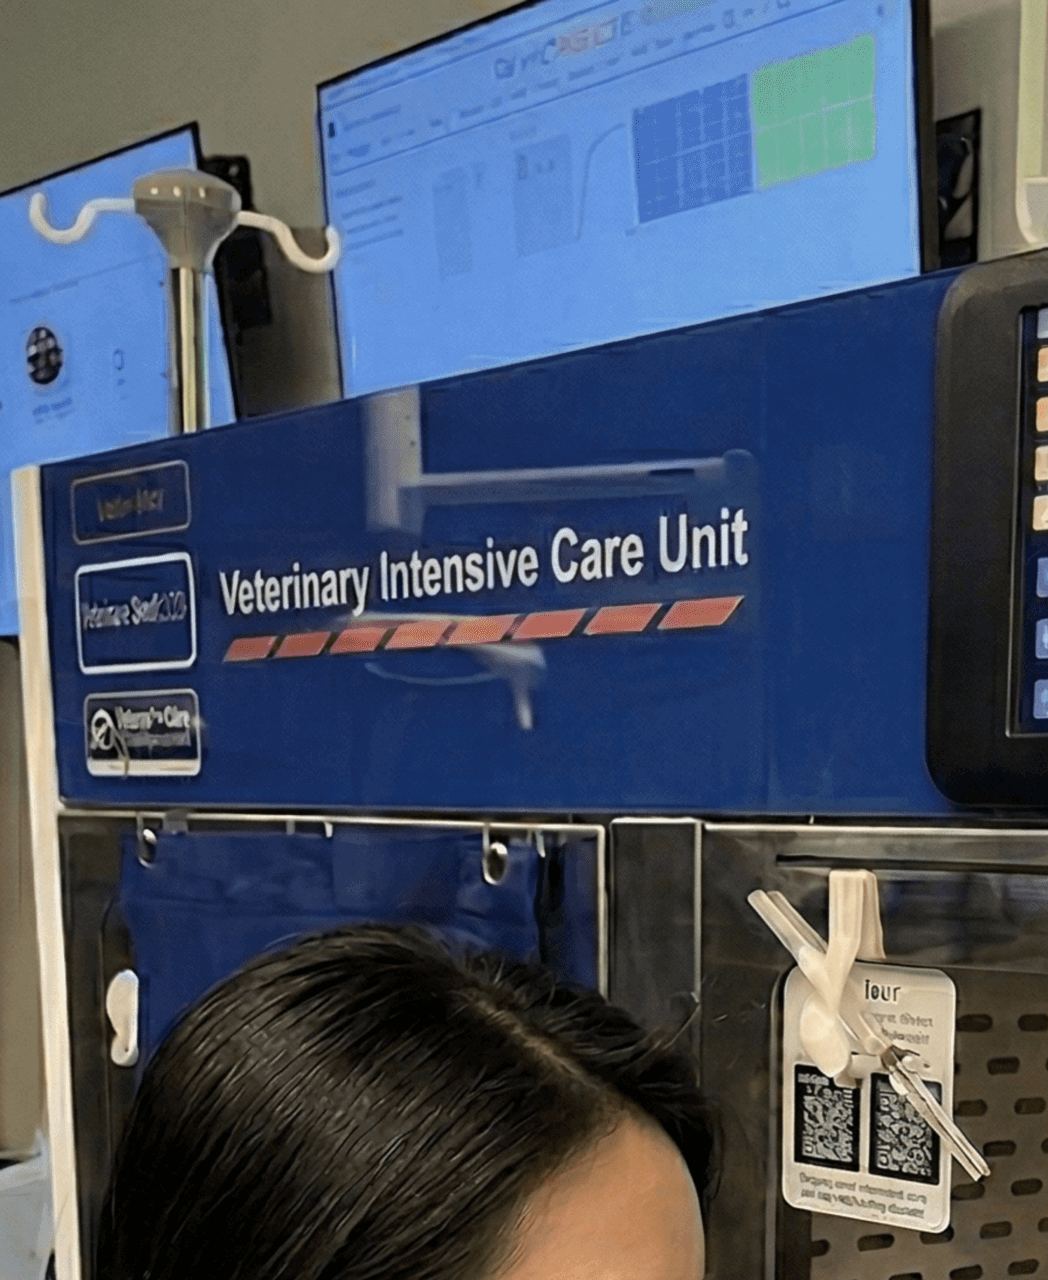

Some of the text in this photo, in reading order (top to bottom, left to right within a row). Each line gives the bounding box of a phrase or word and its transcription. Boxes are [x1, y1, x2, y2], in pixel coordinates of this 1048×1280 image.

[219, 562, 370, 617] Veterinary
[380, 537, 539, 601] Intensive
[551, 527, 644, 583] Care
[658, 508, 749, 573] Unit
